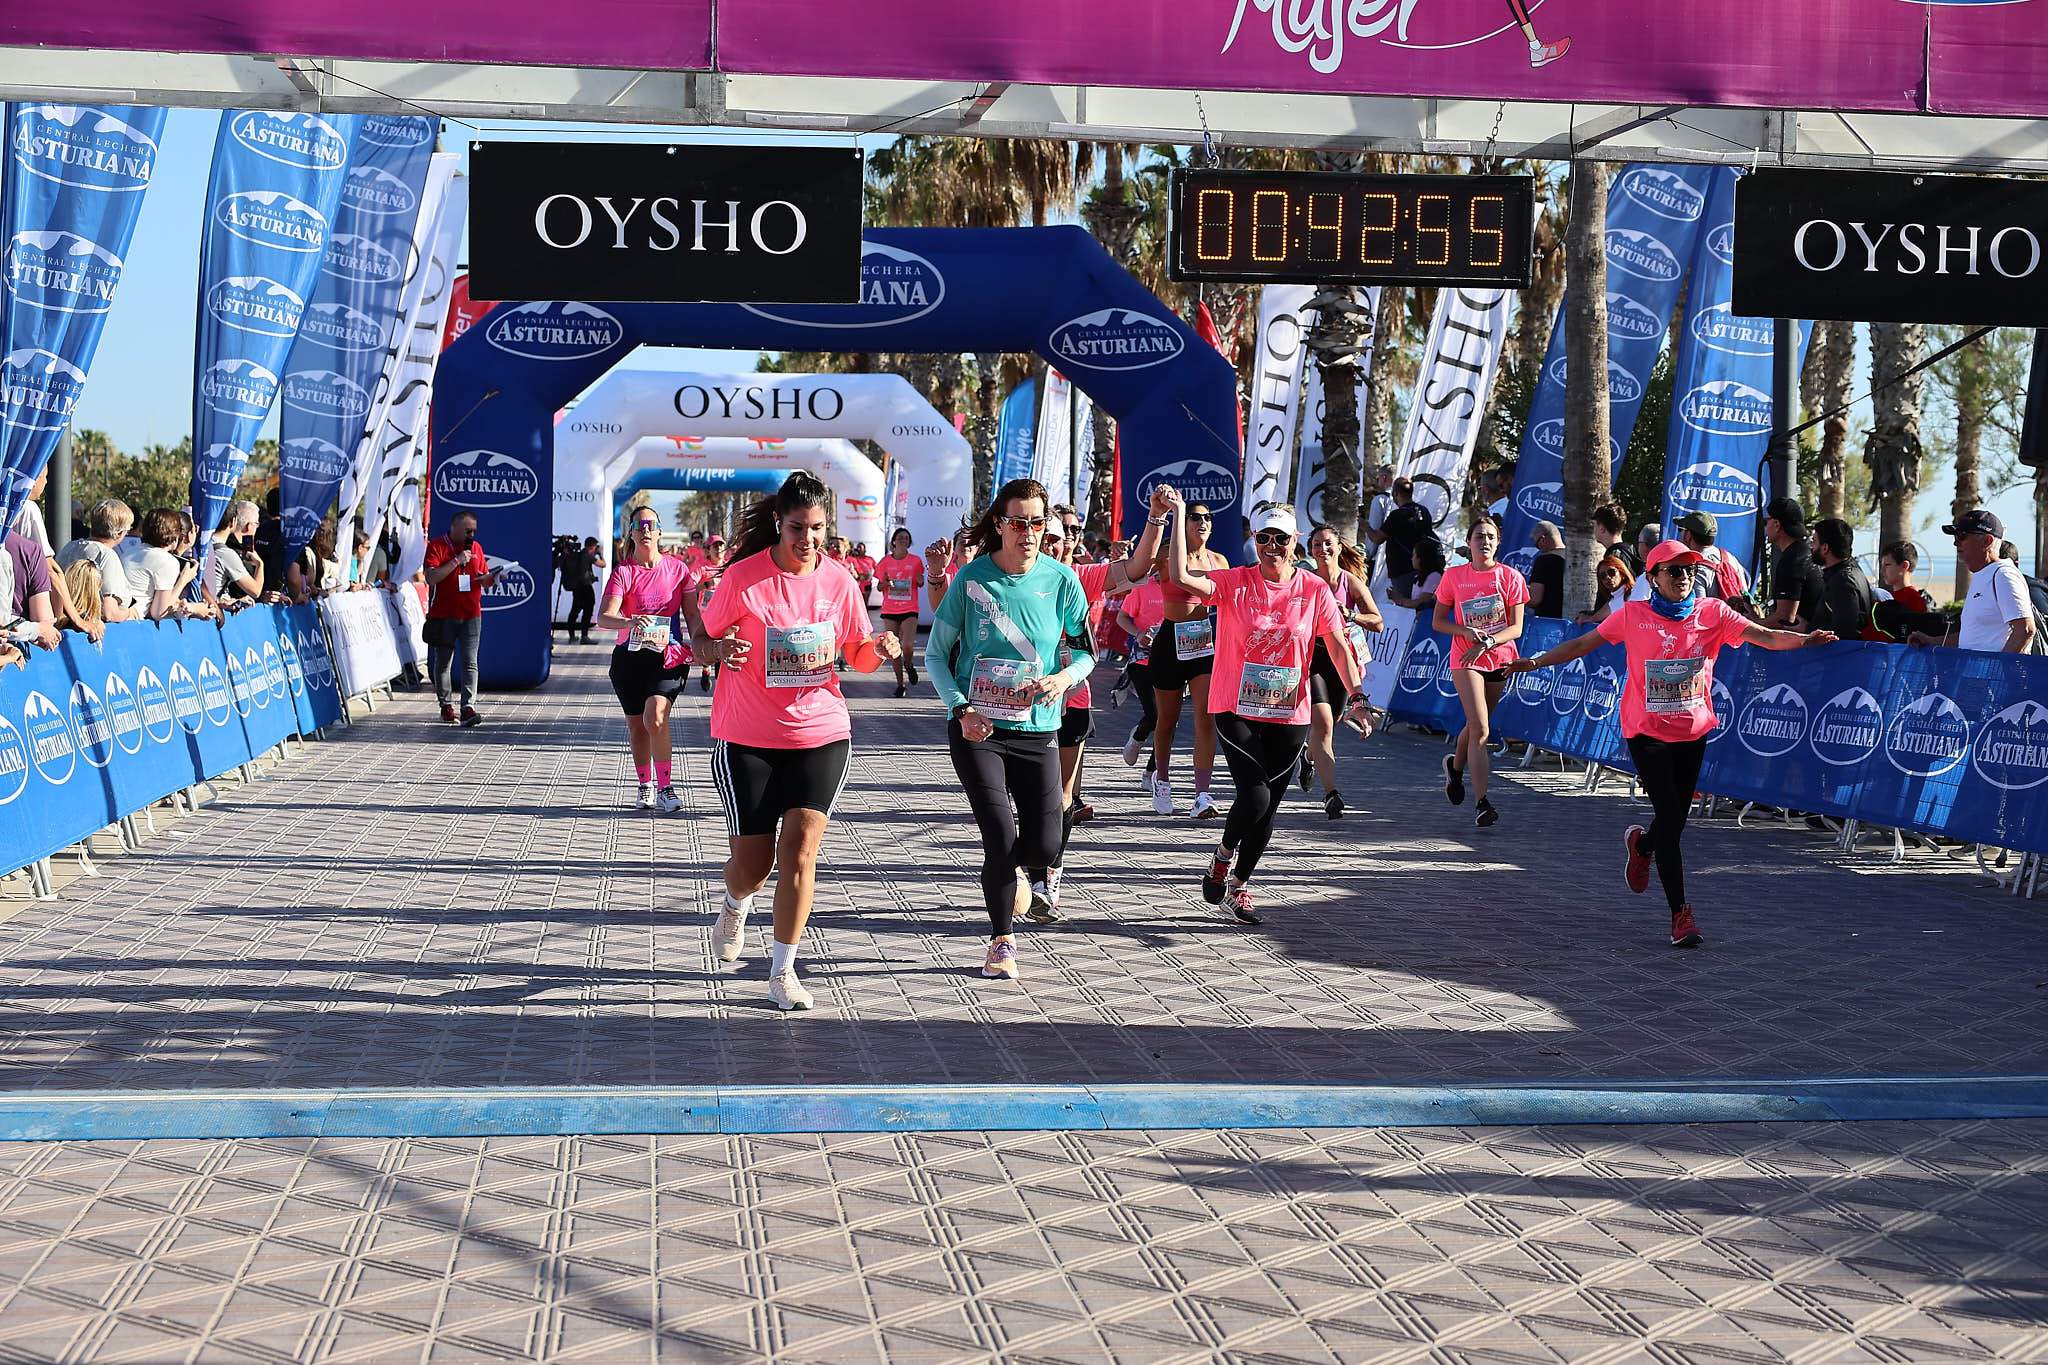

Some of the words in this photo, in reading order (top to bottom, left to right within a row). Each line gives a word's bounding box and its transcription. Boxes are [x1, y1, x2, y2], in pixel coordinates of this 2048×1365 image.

[16, 120, 150, 181] ASTURIANA
[37, 124, 91, 144] CENTRAL
[96, 137, 151, 158] LECHERA
[239, 117, 341, 164] ASTURIANA
[1626, 176, 1699, 218] ASTURIANA
[223, 201, 323, 244] ASTURIANA
[535, 193, 807, 254] OYSHO
[1197, 189, 1504, 267] 00:42:55
[1794, 219, 2041, 279] OYSHO
[494, 320, 612, 345] ASTURIANA
[517, 317, 561, 326] CENTRAL
[564, 319, 610, 328] LECHERA
[1061, 333, 1176, 356] ASTURIANA
[284, 380, 364, 413] ASTURIANA
[674, 385, 843, 421] OYSHO
[1685, 396, 1773, 427] ASTURIANA
[571, 422, 622, 435] OYSHO
[892, 424, 942, 437] OYSHO
[439, 471, 531, 495] ASTURIANA
[1674, 478, 1757, 508] ASTURIANA
[917, 495, 964, 508] OYSHO
[1741, 707, 1801, 740] ASTURIANA
[1814, 713, 1874, 748] ASTURIANA
[1889, 719, 1960, 759] ASTURIANA
